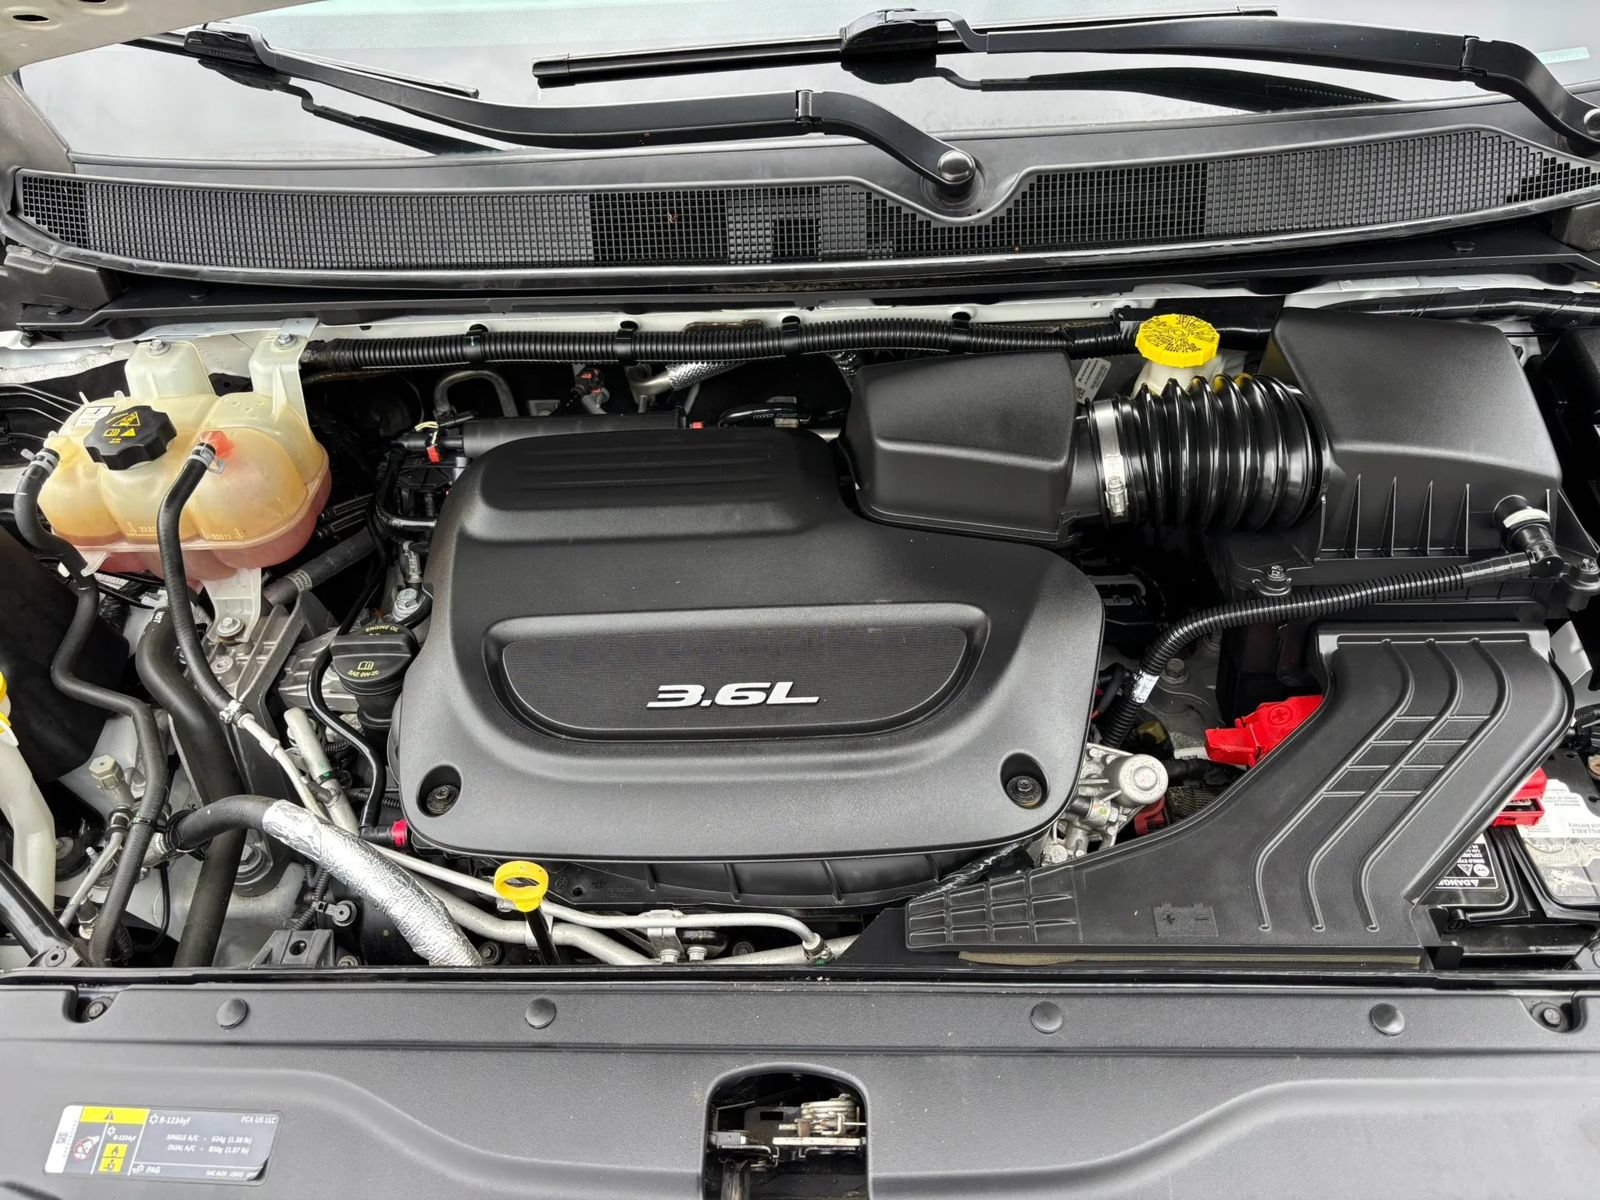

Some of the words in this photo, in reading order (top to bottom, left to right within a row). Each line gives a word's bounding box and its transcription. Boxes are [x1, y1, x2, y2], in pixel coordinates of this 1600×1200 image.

[365, 624, 389, 632] ENGINE
[347, 669, 360, 677] SAE
[646, 681, 820, 708] 3.6L
[240, 1115, 254, 1123] FCA
[264, 1116, 277, 1124] LLC
[166, 1134, 187, 1142] SINGLE
[187, 1134, 200, 1142] A/C
[184, 1144, 197, 1152] A/C
[145, 1166, 161, 1174] PAG
